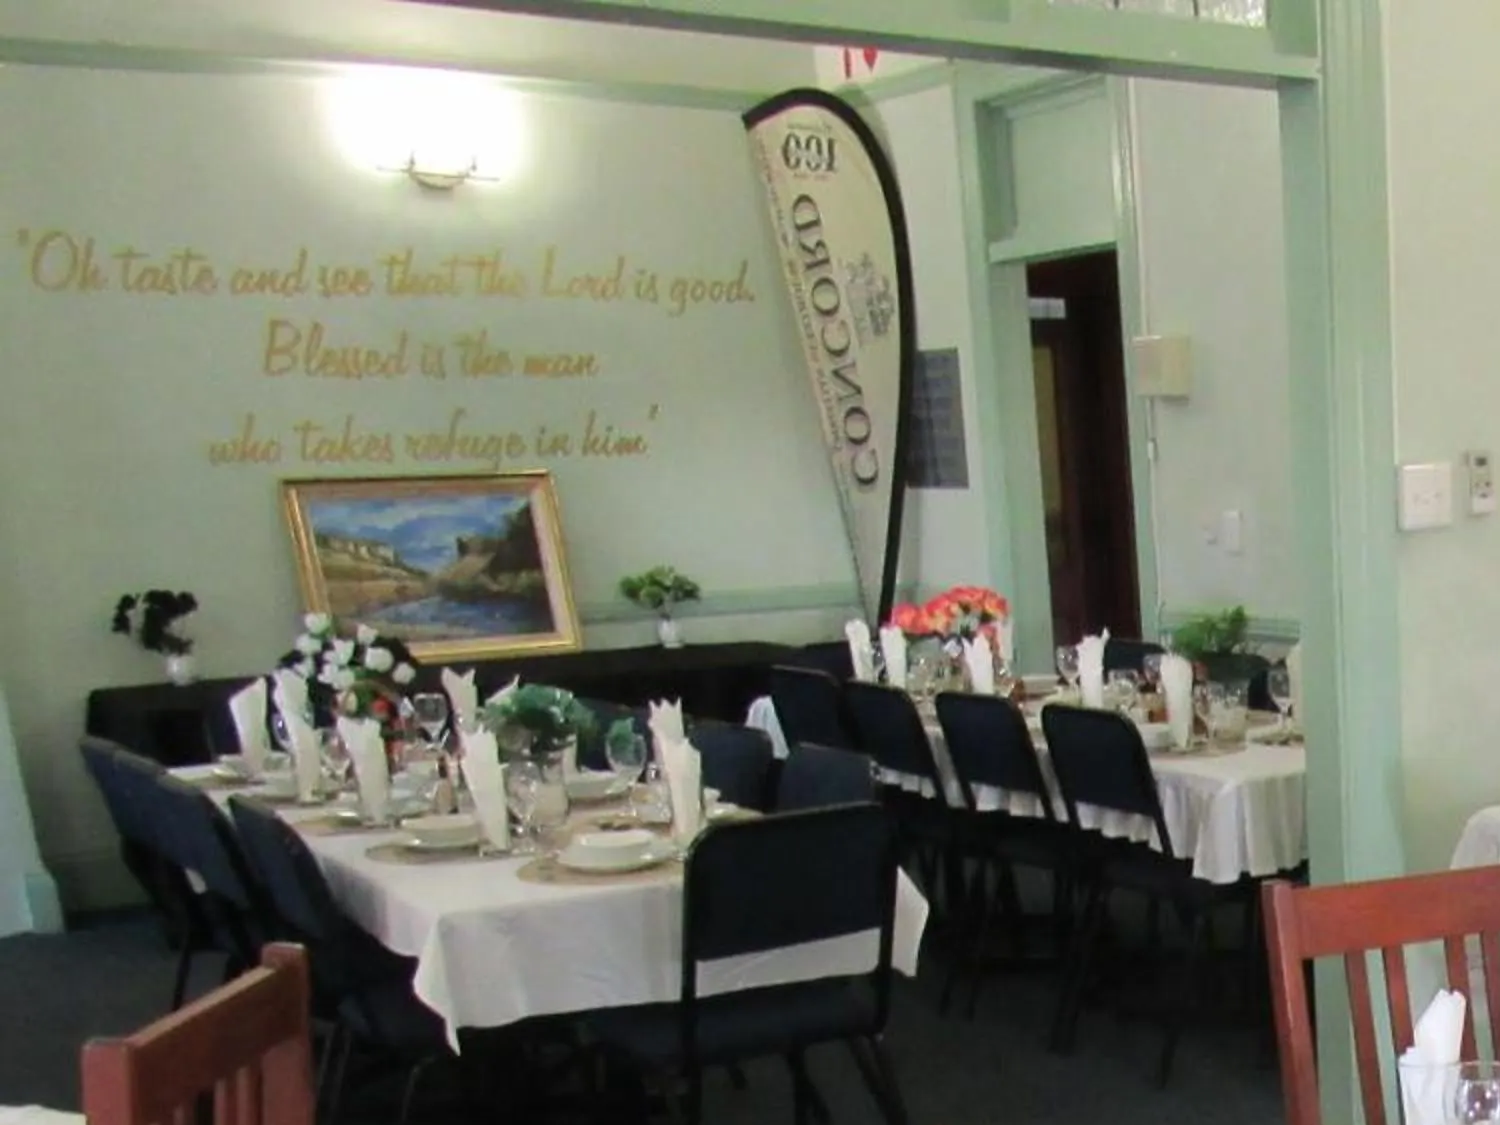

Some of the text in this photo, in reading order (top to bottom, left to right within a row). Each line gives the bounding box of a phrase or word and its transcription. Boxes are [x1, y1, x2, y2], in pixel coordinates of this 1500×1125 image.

[230, 249, 309, 297] and
[541, 244, 626, 302] Lord
[634, 268, 659, 304] is
[264, 318, 408, 379] Blessed
[209, 412, 281, 465] who
[293, 414, 394, 463] takes
[405, 407, 527, 470] refuge
[536, 426, 572, 457] in
